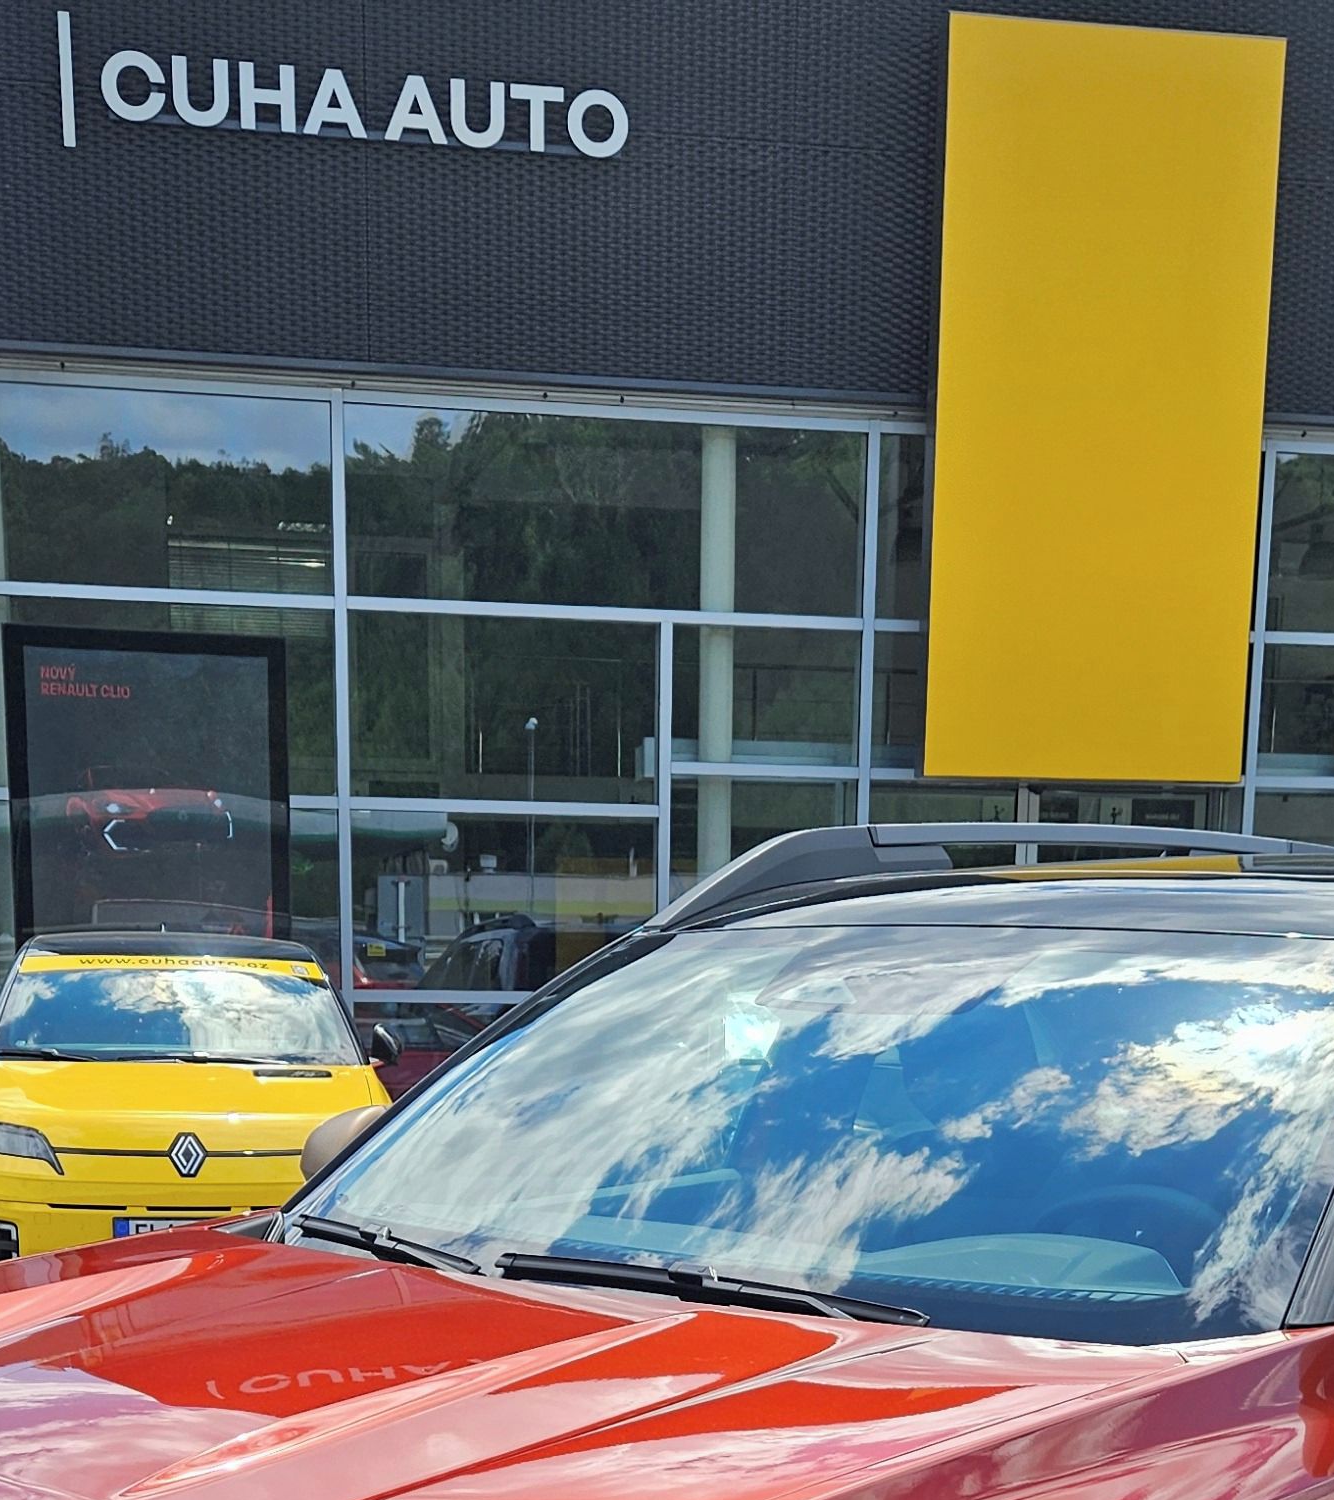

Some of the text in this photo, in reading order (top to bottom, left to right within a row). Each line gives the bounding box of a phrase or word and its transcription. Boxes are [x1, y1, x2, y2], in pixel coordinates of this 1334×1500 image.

[100, 49, 629, 158] CUHA AUTO
[40, 664, 76, 680] NOVÝ
[41, 682, 130, 698] RENAULT CLIO
[79, 957, 270, 970] www.cuhaauto.cz
